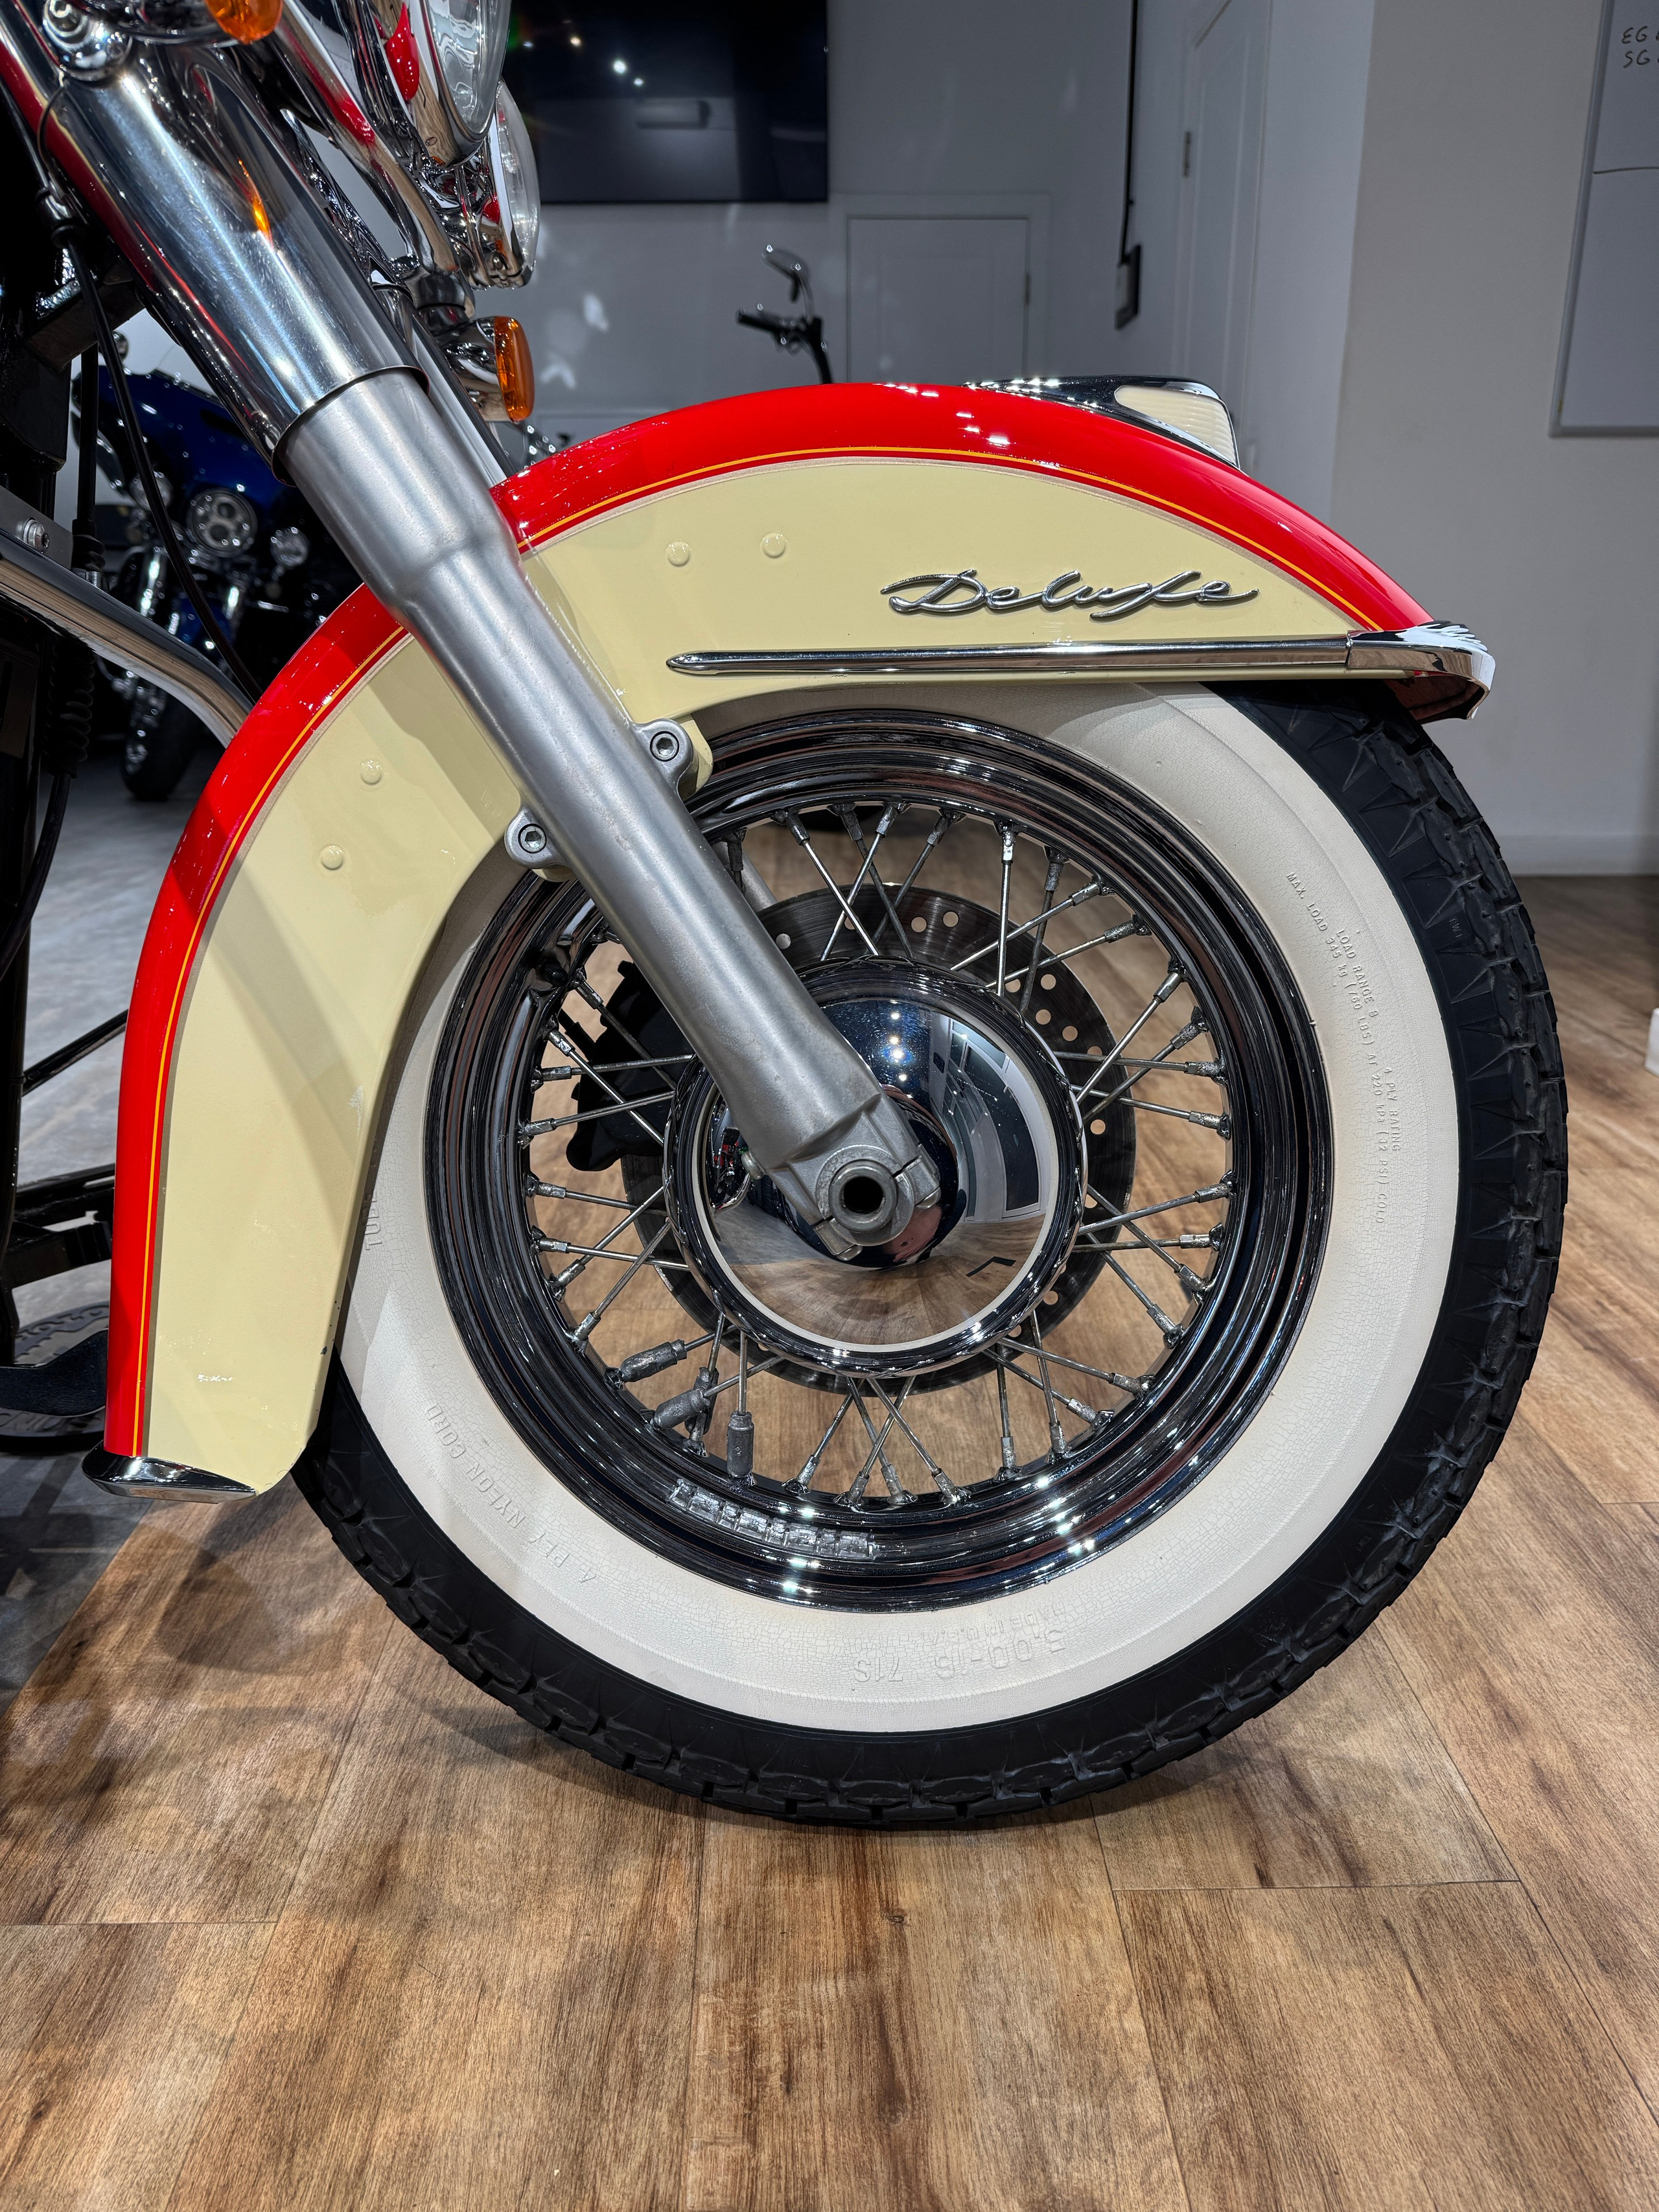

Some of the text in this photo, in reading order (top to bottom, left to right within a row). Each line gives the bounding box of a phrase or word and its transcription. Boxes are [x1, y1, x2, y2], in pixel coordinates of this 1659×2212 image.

[1621, 25, 1648, 44] EG
[1622, 49, 1650, 68] SG
[879, 568, 1260, 618] Deluxe
[1336, 929, 1356, 959] LOAD
[1353, 964, 1375, 1003] RANGE
[1286, 872, 1306, 899] MAX.
[1306, 902, 1328, 931] LOAD
[1326, 937, 1341, 958] 345
[1375, 1193, 1387, 1223] COLD
[1386, 1082, 1397, 1101] PLY
[1389, 1110, 1400, 1151] RATING
[425, 1405, 467, 1459] CORD
[465, 1461, 526, 1529] NYLON
